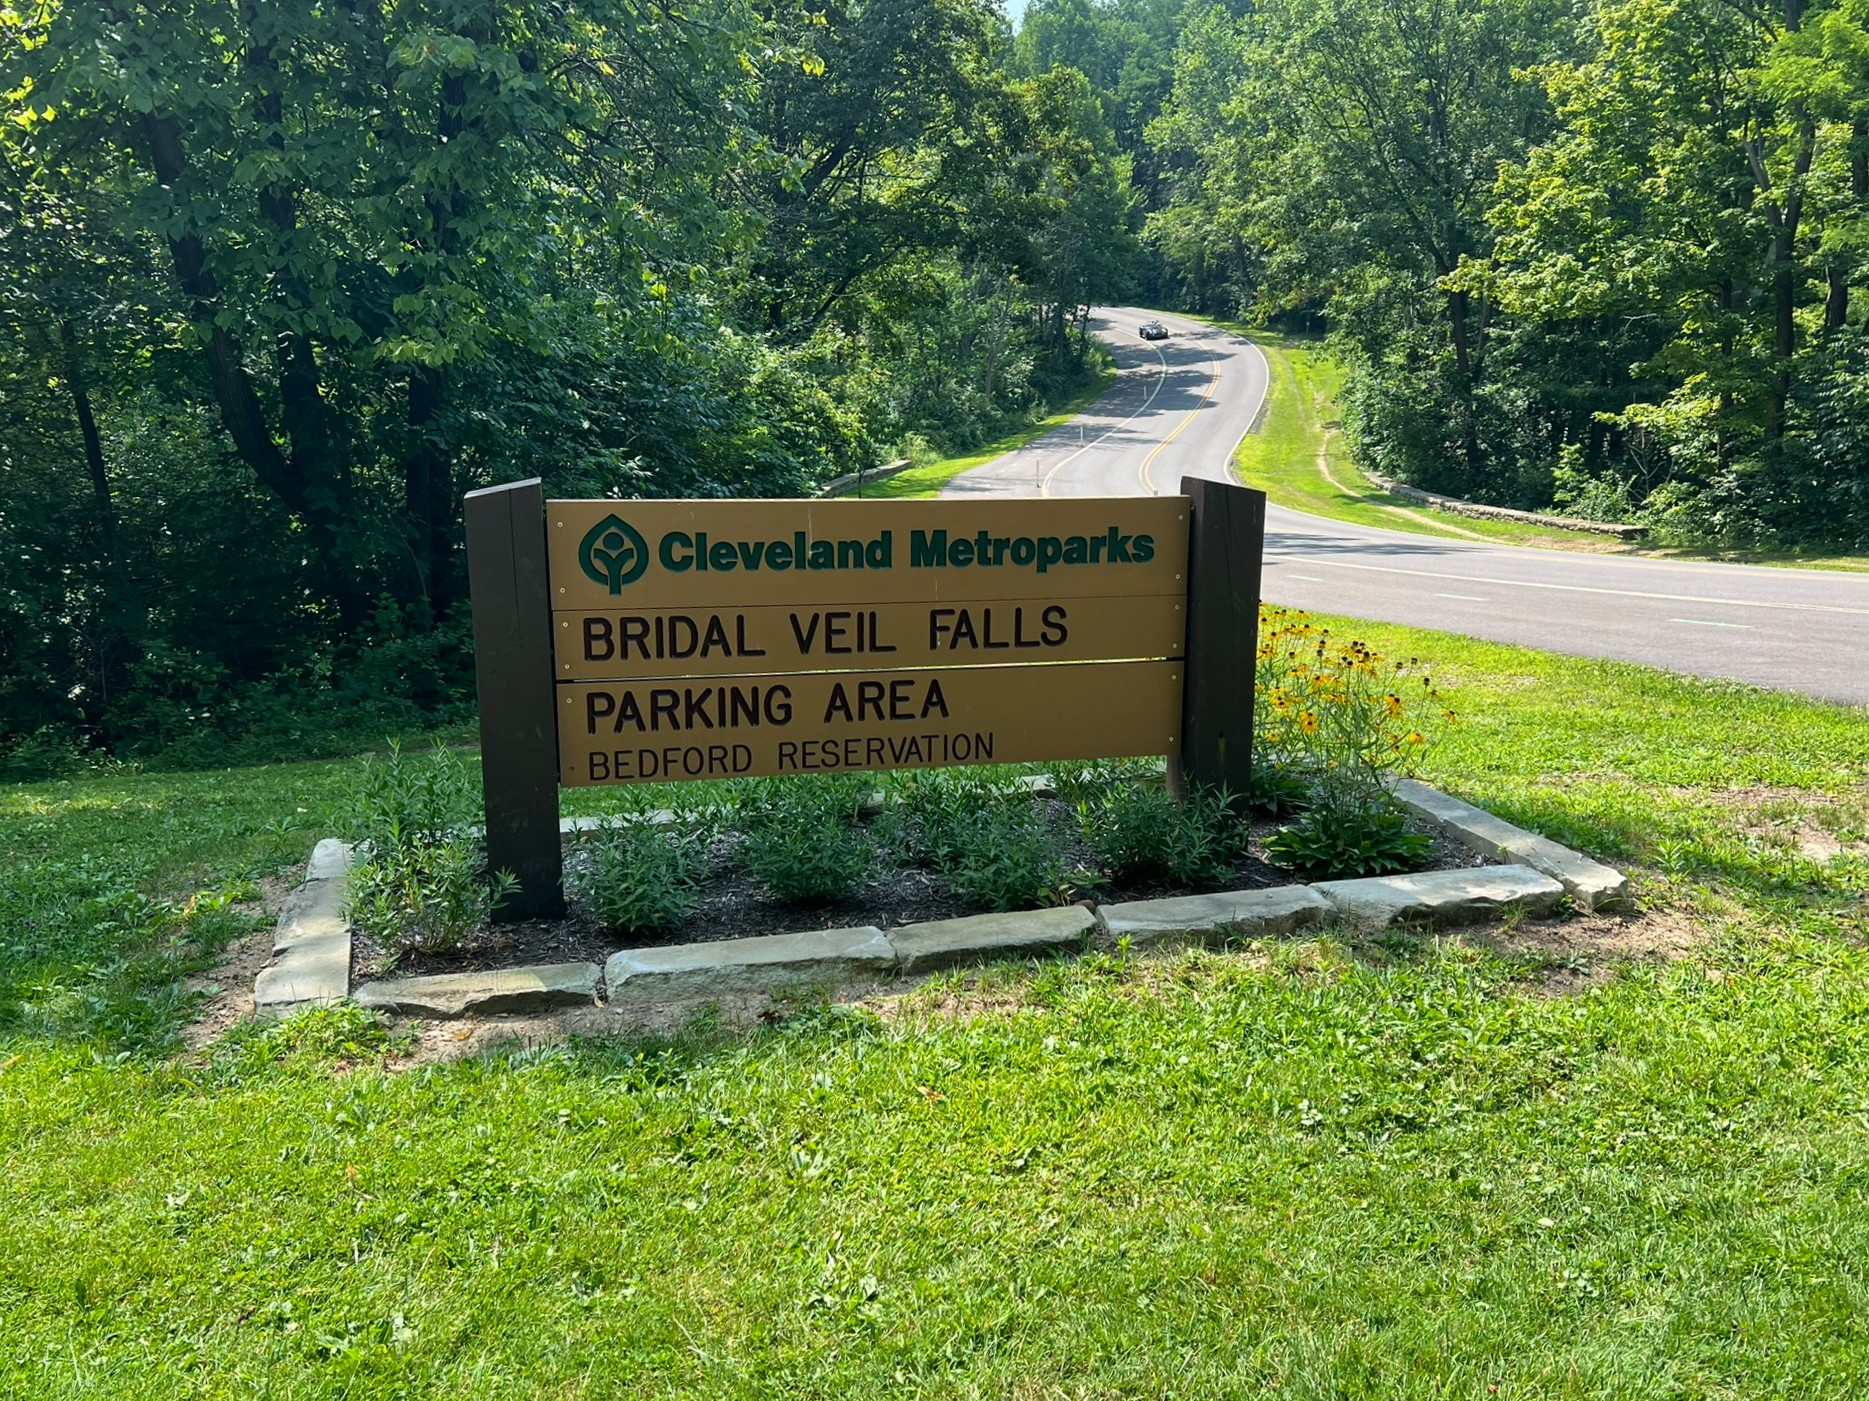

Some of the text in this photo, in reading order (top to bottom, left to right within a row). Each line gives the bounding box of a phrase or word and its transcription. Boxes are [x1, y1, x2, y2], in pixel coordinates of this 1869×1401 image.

[659, 526, 1155, 573] Cleveland Metroparks
[583, 605, 1068, 661] BRIDAL VEIL FALLS
[586, 679, 949, 734] PARKING AREA
[588, 732, 994, 781] BEDFORD RESERVATION
